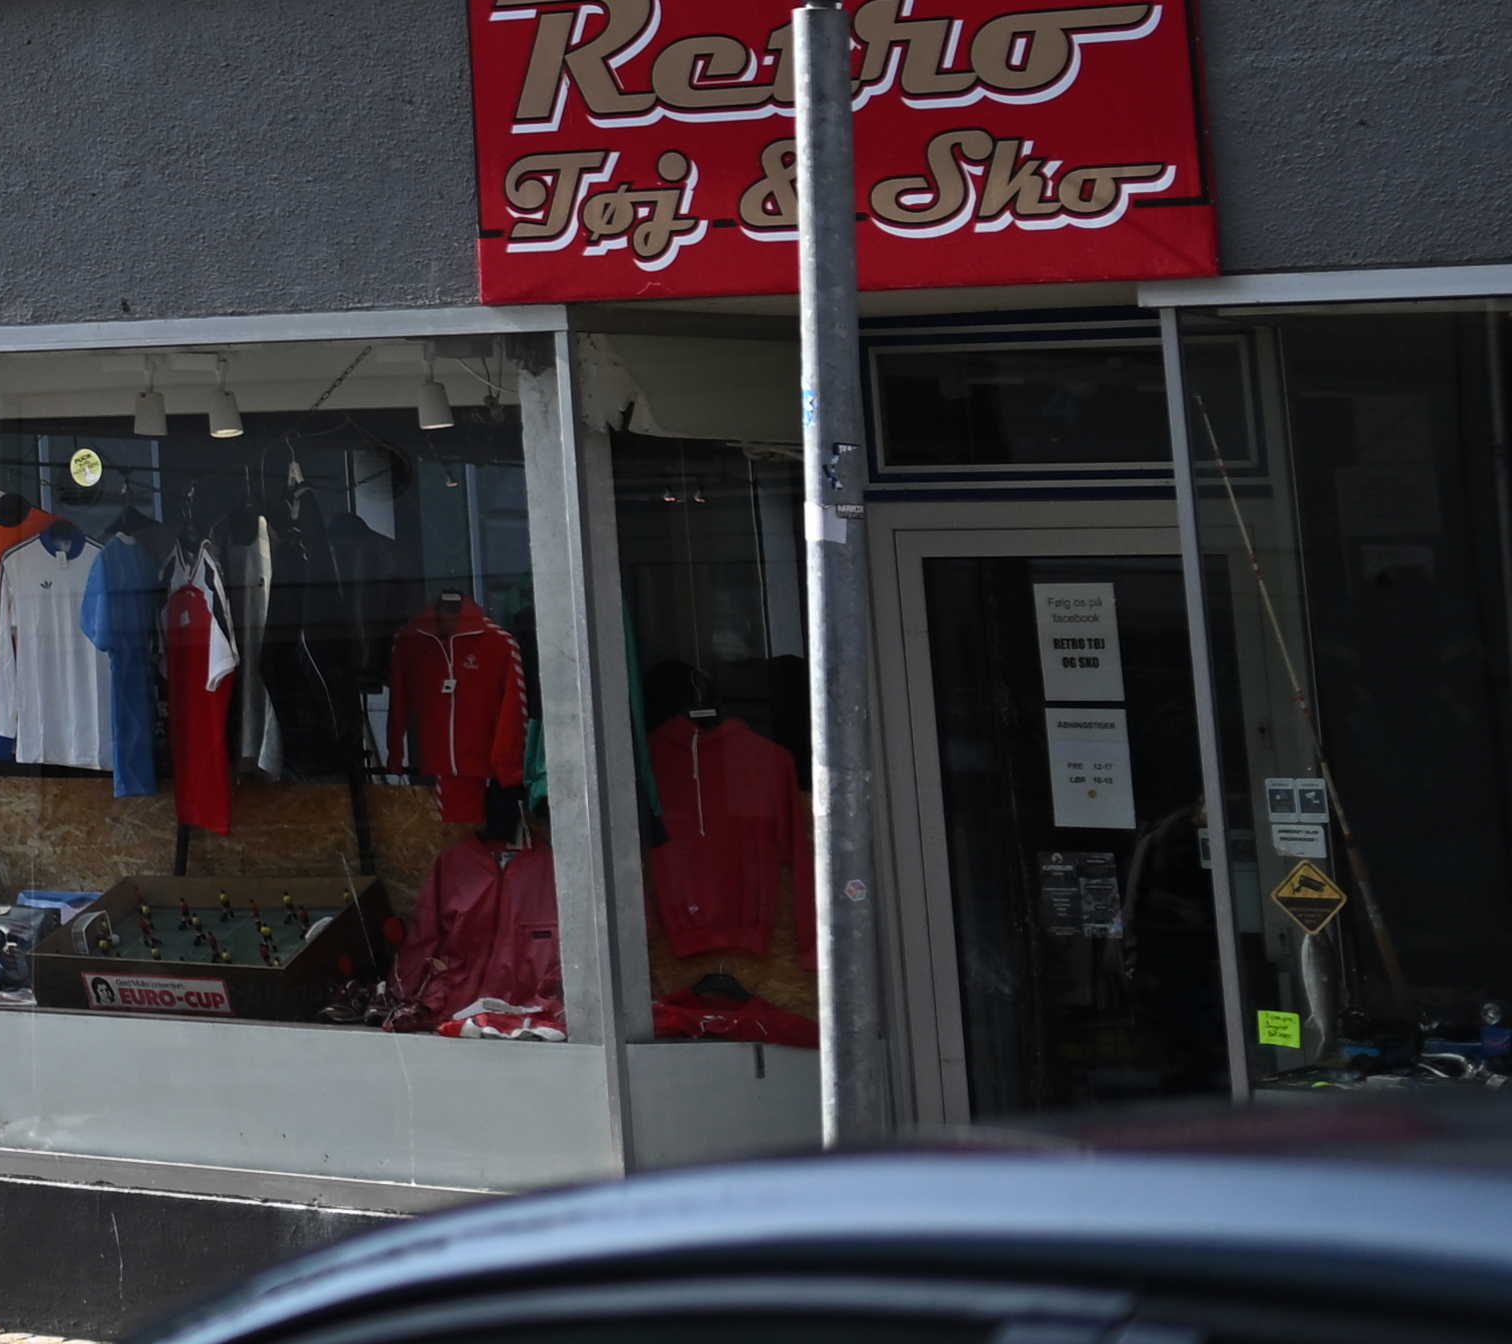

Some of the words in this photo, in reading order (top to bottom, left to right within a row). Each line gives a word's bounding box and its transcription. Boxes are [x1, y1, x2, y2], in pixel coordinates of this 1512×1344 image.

[504, 149, 708, 272] Tøj
[738, 137, 801, 242] &
[869, 129, 1176, 238] Sko
[1048, 596, 1071, 609] Følg
[1088, 596, 1103, 610] på
[1052, 613, 1099, 624] facebook
[119, 987, 225, 1010] EURO-CUP
